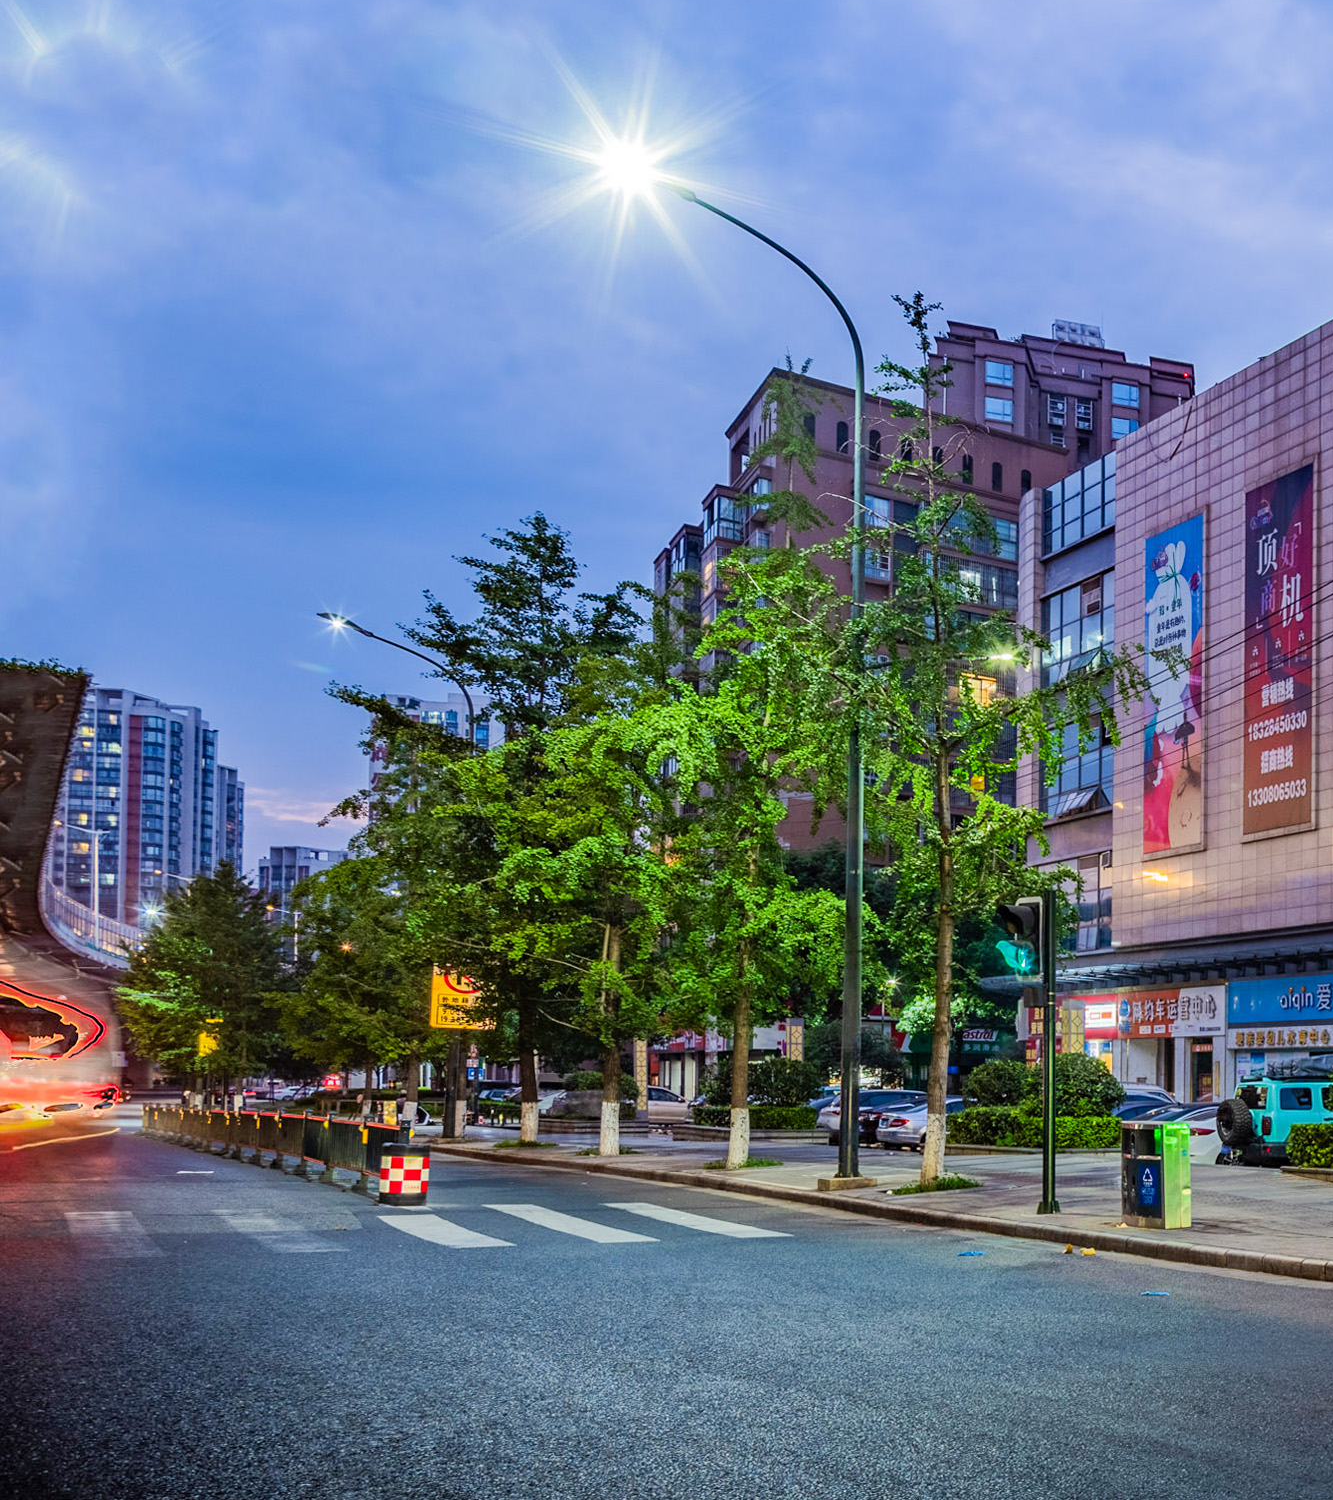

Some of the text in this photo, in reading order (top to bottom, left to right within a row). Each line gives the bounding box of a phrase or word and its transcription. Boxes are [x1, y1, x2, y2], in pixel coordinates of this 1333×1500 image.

[1247, 777, 1308, 809] 13308065033
[1132, 994, 1217, 1023] 网约车运营中心
[1280, 987, 1314, 1011] aiqin
[963, 1030, 994, 1040] astrol
